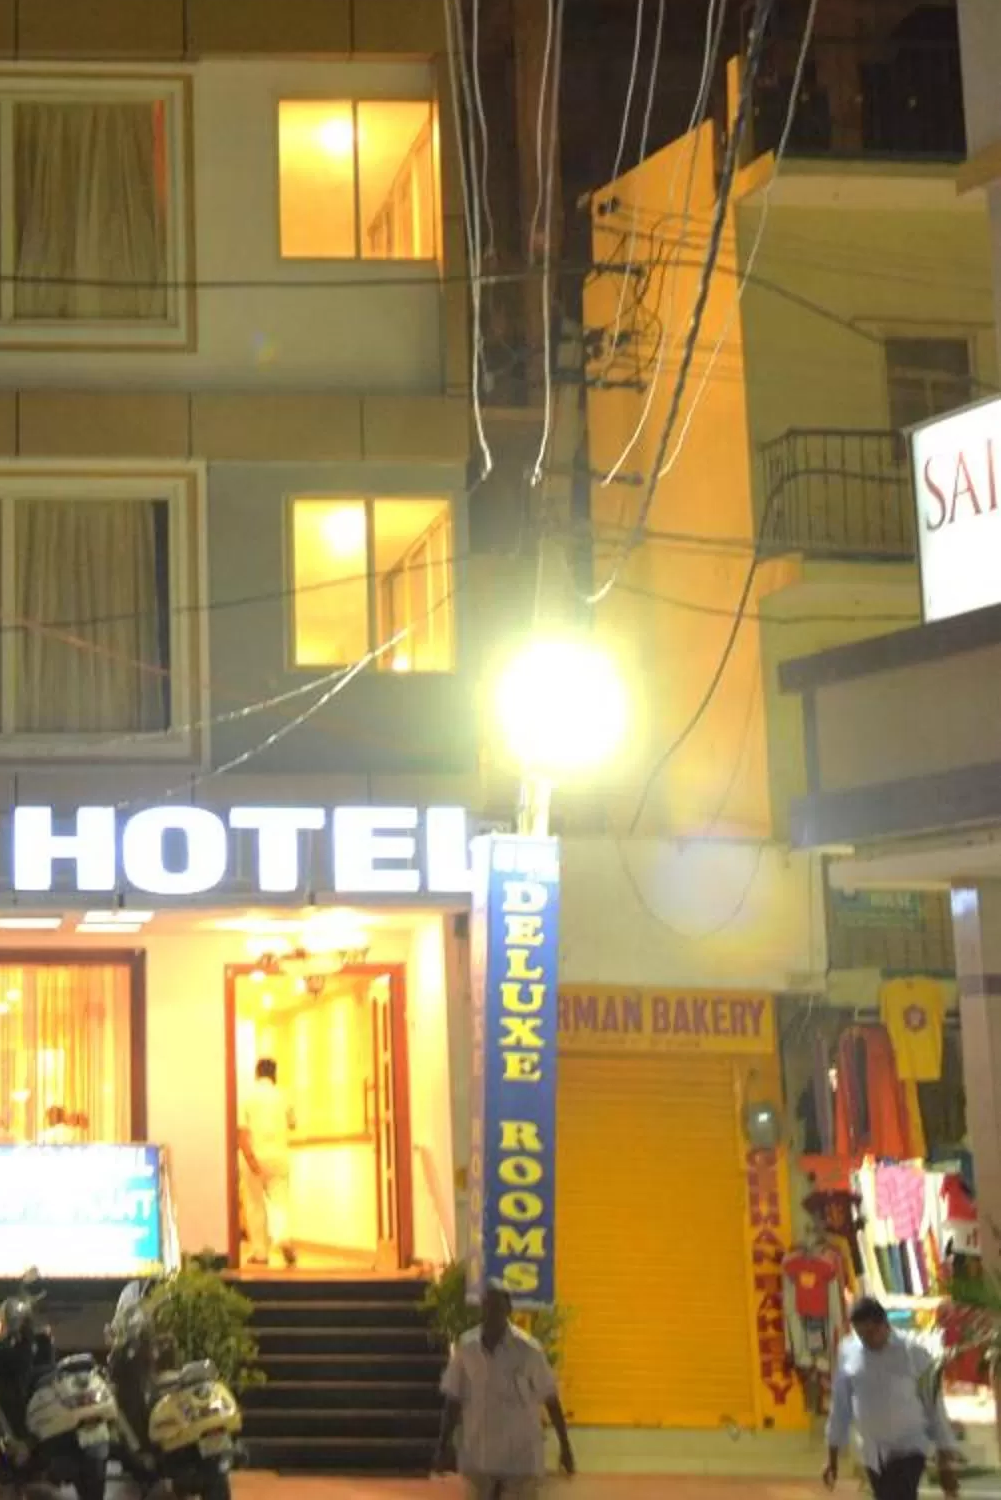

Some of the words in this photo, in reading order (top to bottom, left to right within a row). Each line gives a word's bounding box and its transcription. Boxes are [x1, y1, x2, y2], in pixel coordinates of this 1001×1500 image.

[13, 805, 475, 896] HOTEL
[499, 880, 549, 1080] DELUXE
[651, 995, 765, 1036] BAKERY
[495, 1120, 547, 1293] ROOMS
